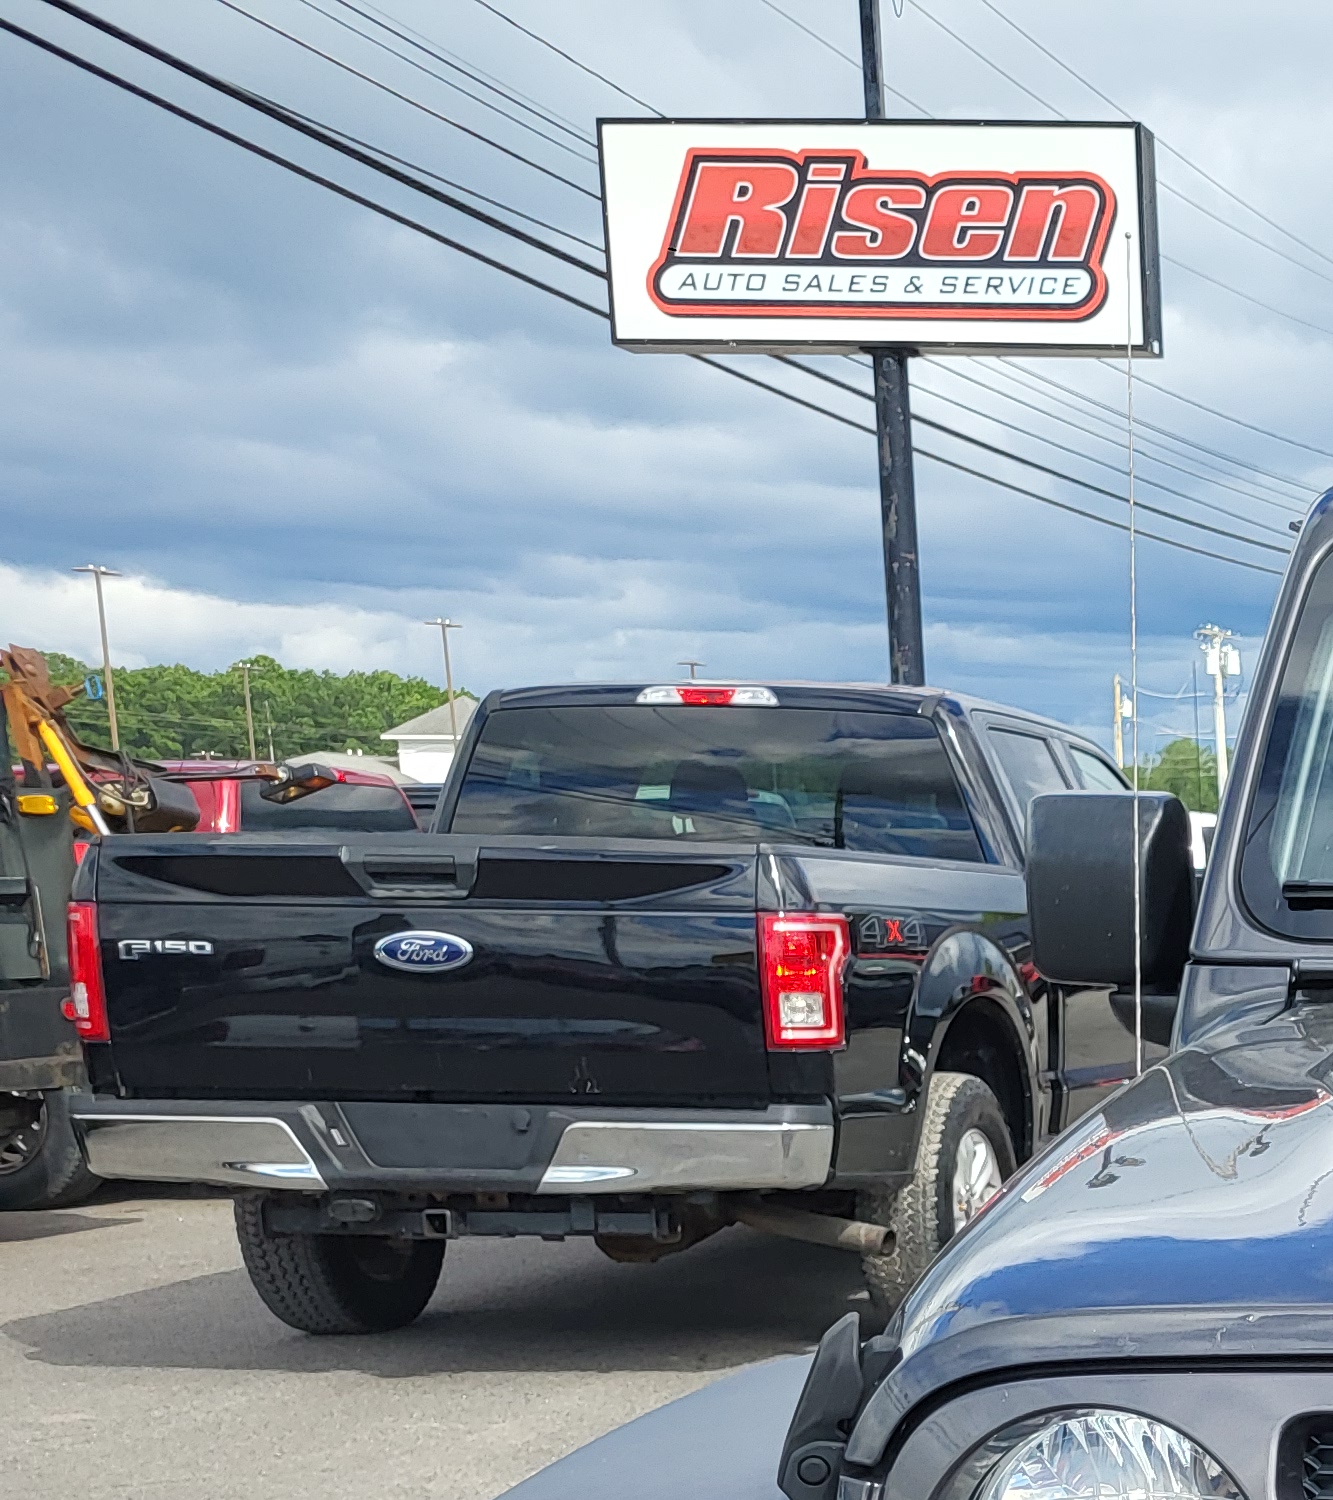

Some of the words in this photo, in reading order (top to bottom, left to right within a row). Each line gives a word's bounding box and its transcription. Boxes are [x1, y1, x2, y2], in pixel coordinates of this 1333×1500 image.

[674, 162, 1101, 262] Risen
[678, 272, 766, 292] AUTO
[782, 274, 889, 293] SALES
[904, 275, 924, 294] &
[939, 276, 1081, 295] SERVICE
[397, 939, 449, 962] Ford
